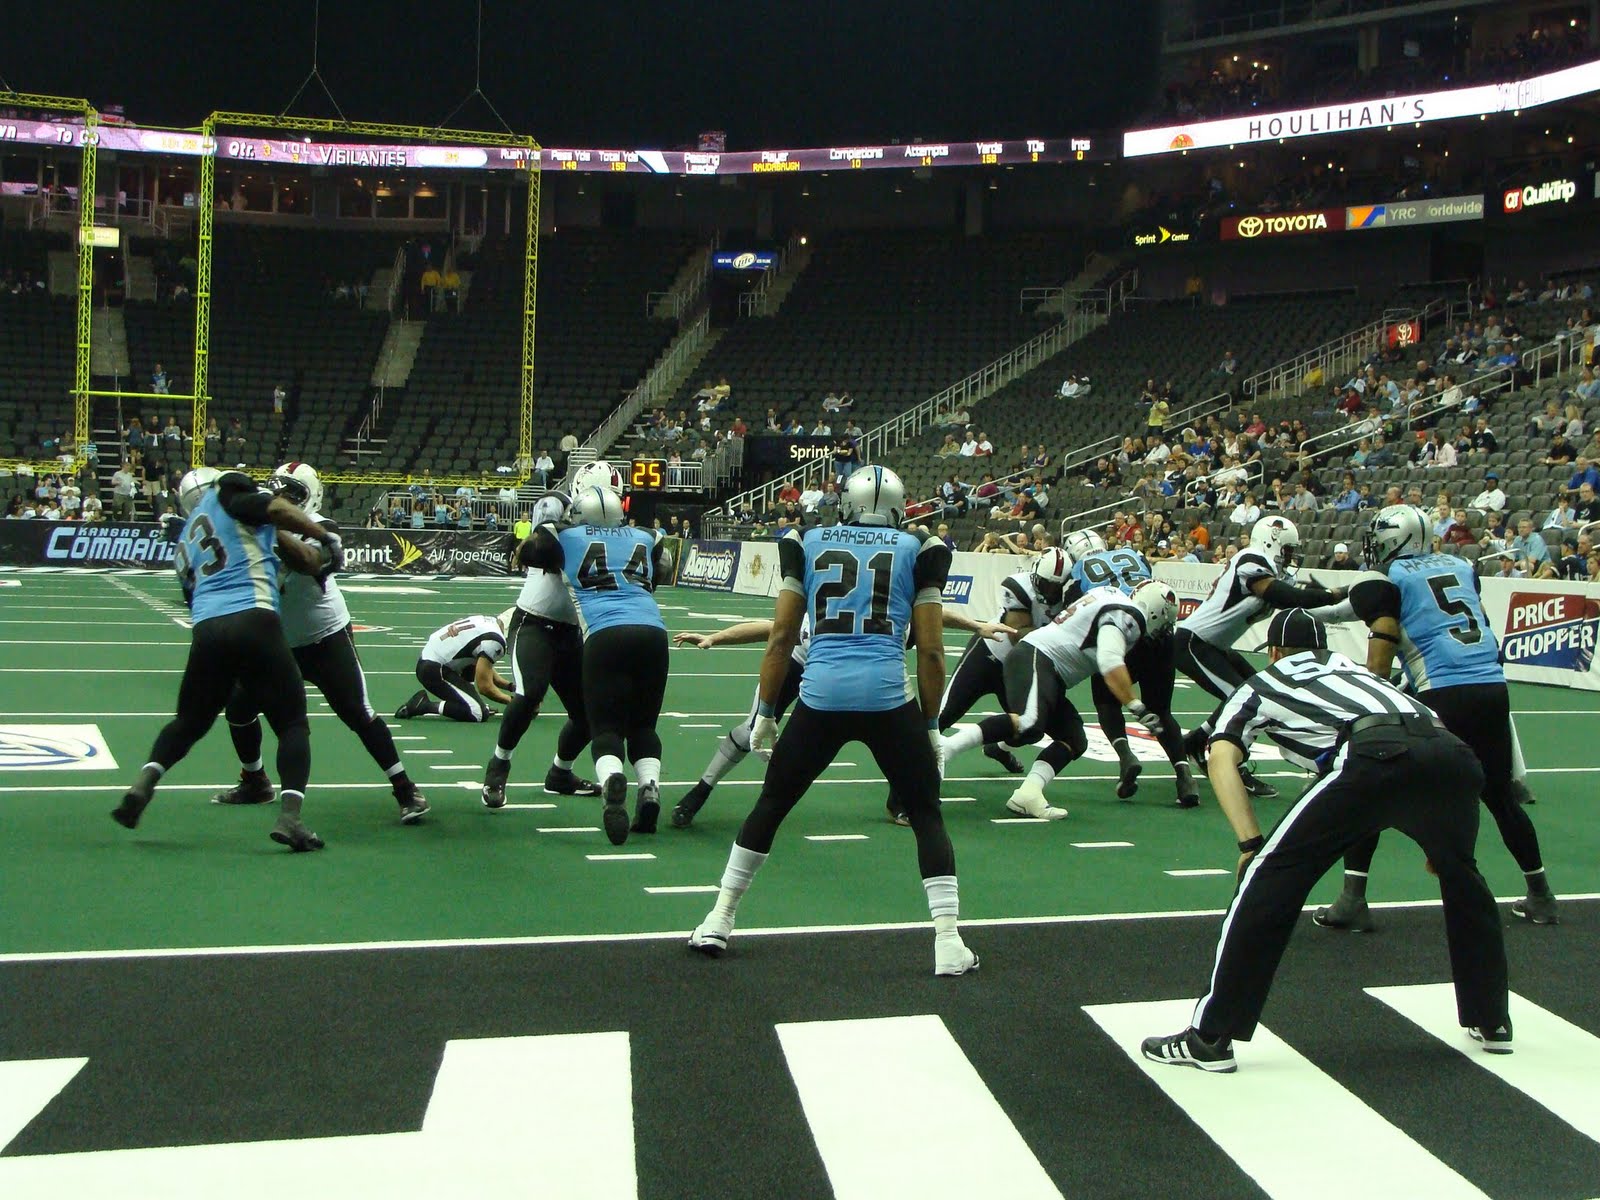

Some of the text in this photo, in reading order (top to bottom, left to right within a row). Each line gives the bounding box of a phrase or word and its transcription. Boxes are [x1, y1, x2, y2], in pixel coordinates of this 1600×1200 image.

[1249, 99, 1425, 139] HOULIHAN'S
[56, 127, 73, 143] To
[228, 141, 255, 158] Qtr.
[319, 145, 406, 166] VIGILANTES
[1505, 192, 1520, 210] QT
[1522, 178, 1576, 206] QuikTrip
[1389, 200, 1482, 221] YRC orldwide
[1265, 213, 1328, 233] TOYOTA
[1135, 232, 1189, 246] Sprint Center
[790, 445, 830, 459] Sprint
[633, 463, 661, 487] 25
[77, 528, 139, 538] KANSAS
[585, 526, 633, 537] BRYANT
[821, 529, 899, 546] BARKSDALE
[344, 544, 392, 566] print
[428, 548, 447, 562] All.
[449, 549, 506, 563] Together.
[682, 543, 734, 583] Aaron's
[577, 541, 653, 594] 44
[1083, 553, 1144, 589] 92
[814, 549, 895, 636] 21
[1426, 573, 1482, 646] 5
[1513, 596, 1566, 630] PRICE
[1504, 624, 1595, 661] CHOPPER
